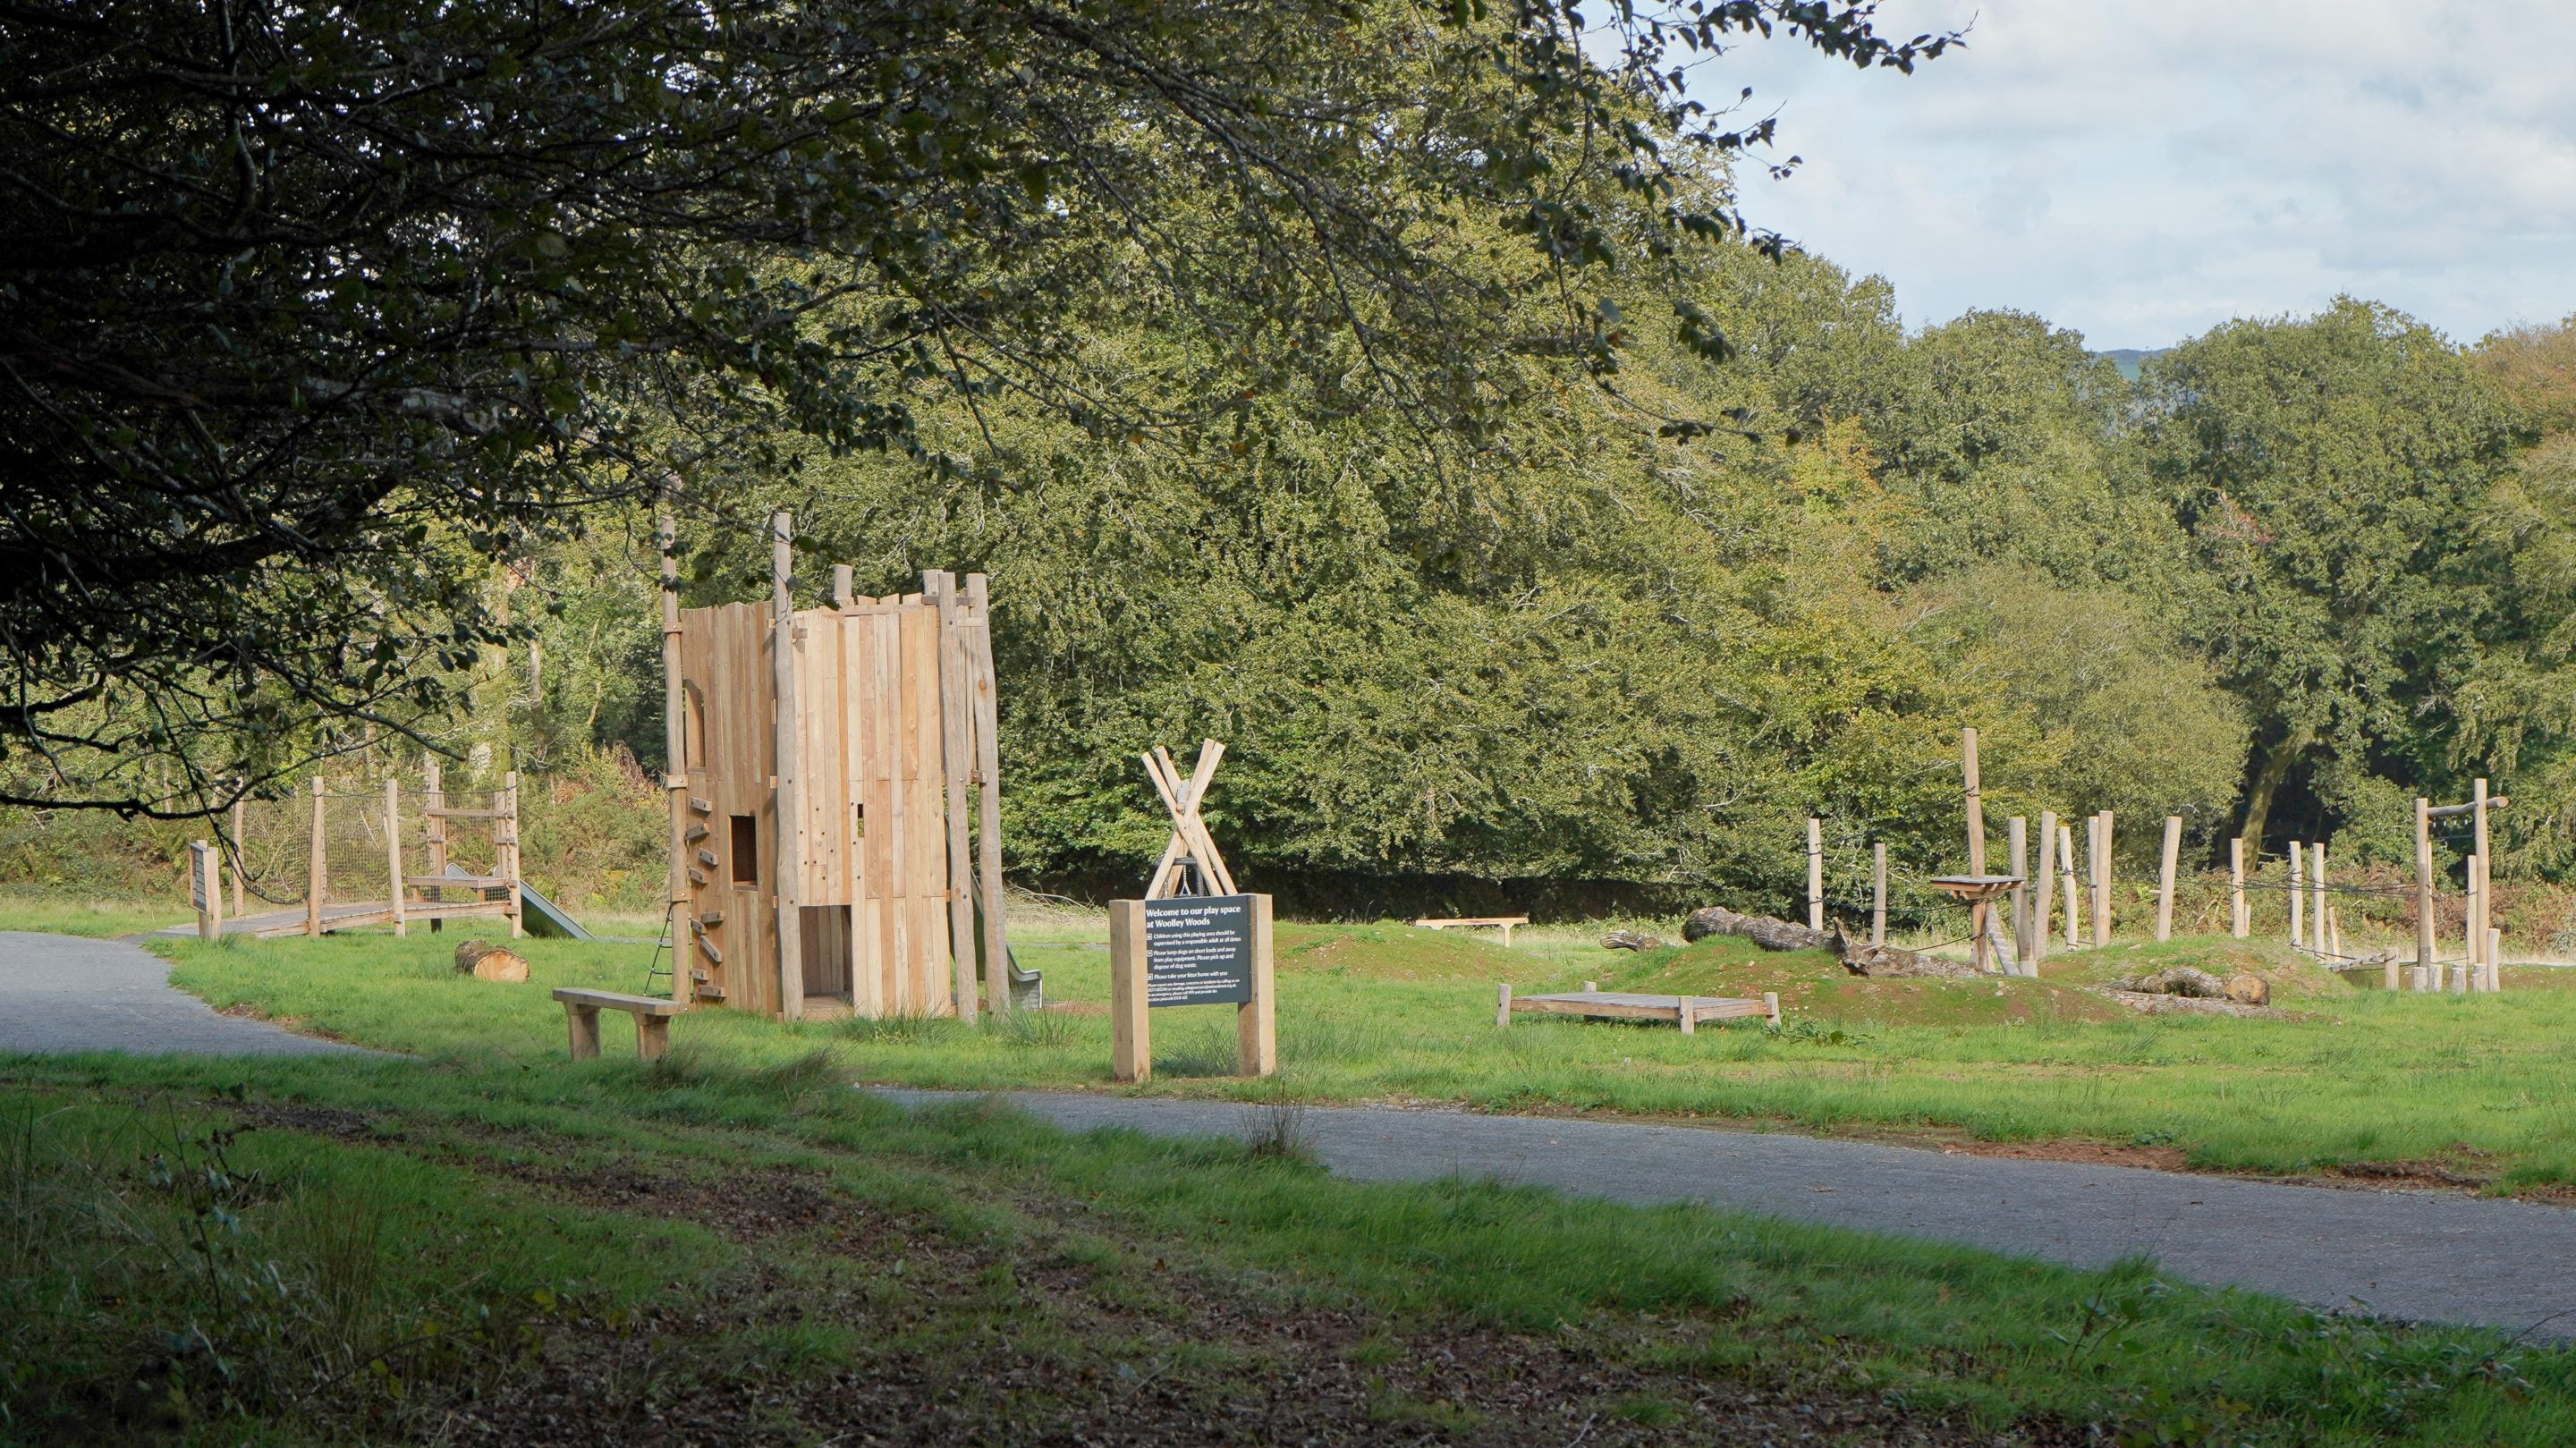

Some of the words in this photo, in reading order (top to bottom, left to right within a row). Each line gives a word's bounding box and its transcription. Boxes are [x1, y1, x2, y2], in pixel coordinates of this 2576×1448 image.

[1146, 909, 1179, 917] Welcome
[1204, 906, 1219, 916] play
[1220, 906, 1241, 915] space
[1155, 919, 1184, 927] Woolley
[1185, 918, 1210, 926] Woods
